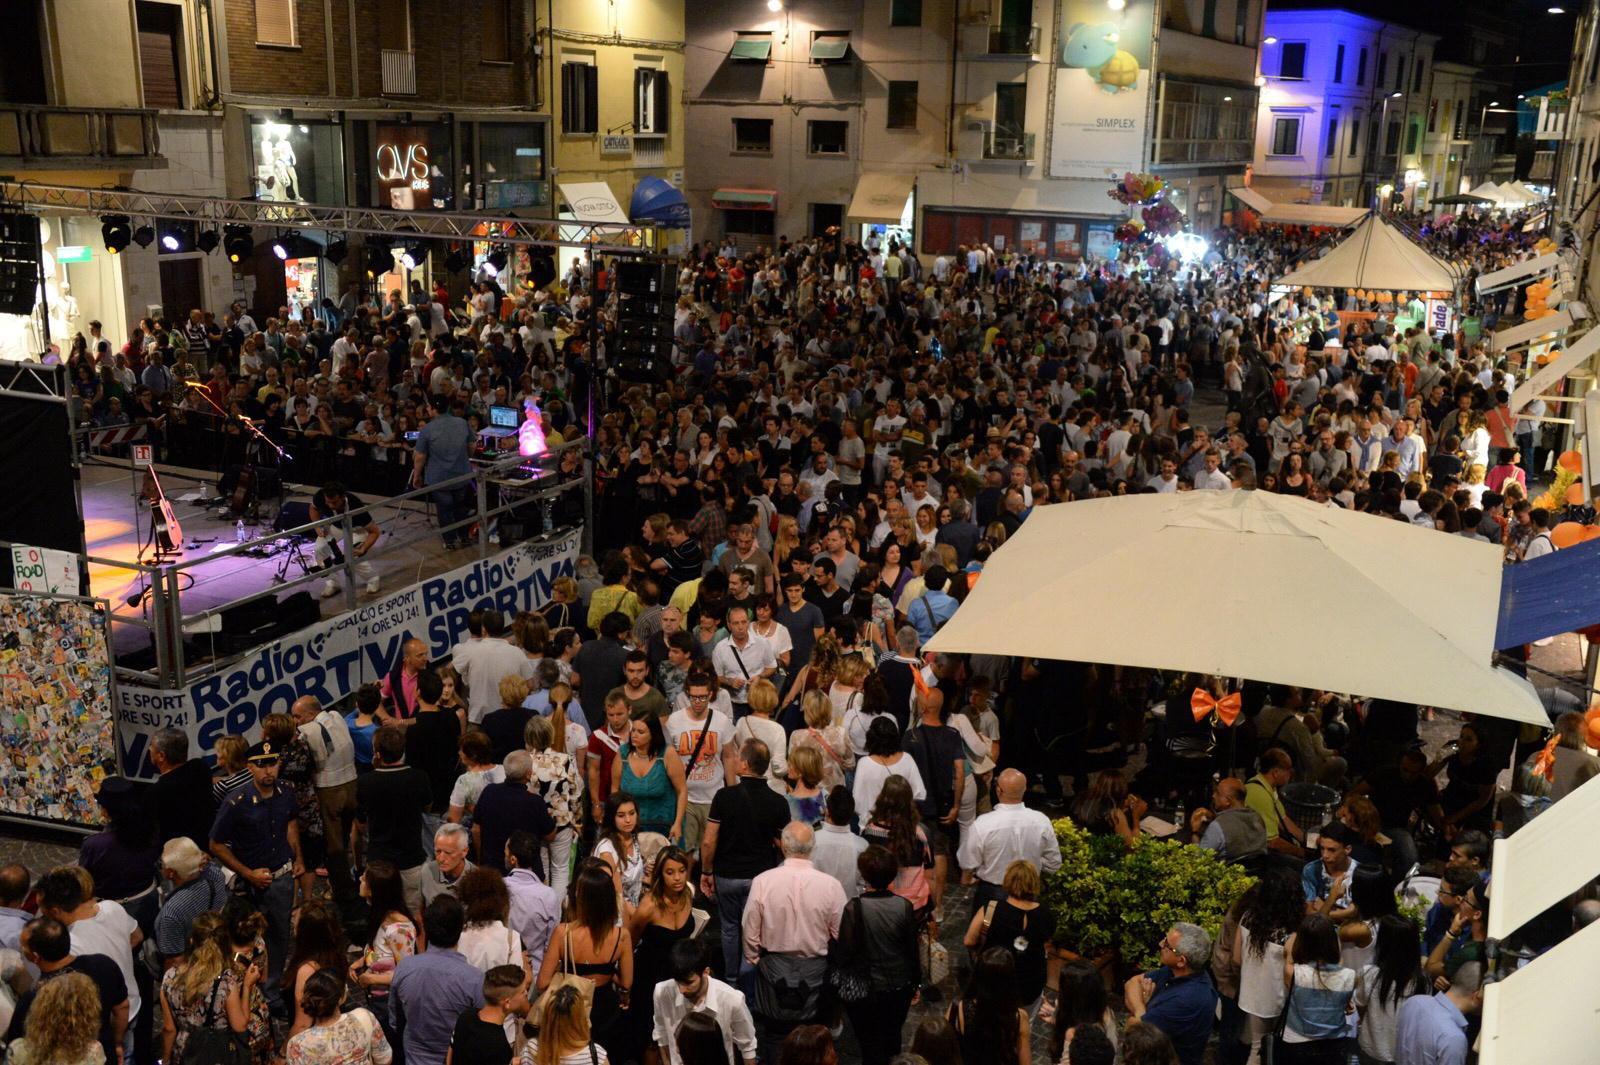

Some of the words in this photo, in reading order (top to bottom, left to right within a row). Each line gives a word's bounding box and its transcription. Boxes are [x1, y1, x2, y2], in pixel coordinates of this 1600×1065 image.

[1096, 118, 1136, 129] SIMPLEX
[377, 144, 429, 180] OVS
[16, 564, 43, 578] ROAD
[422, 560, 503, 617] Radio
[336, 605, 376, 631] CALCIO
[377, 603, 384, 616] E
[385, 590, 417, 612] SPORT
[371, 616, 392, 635] ORE
[391, 613, 404, 627] SU
[405, 605, 420, 620] 24!
[189, 642, 304, 724] Radio
[121, 692, 130, 706] E
[134, 694, 186, 710] SPORT
[140, 713, 160, 728] SU
[164, 711, 189, 729] 24!
